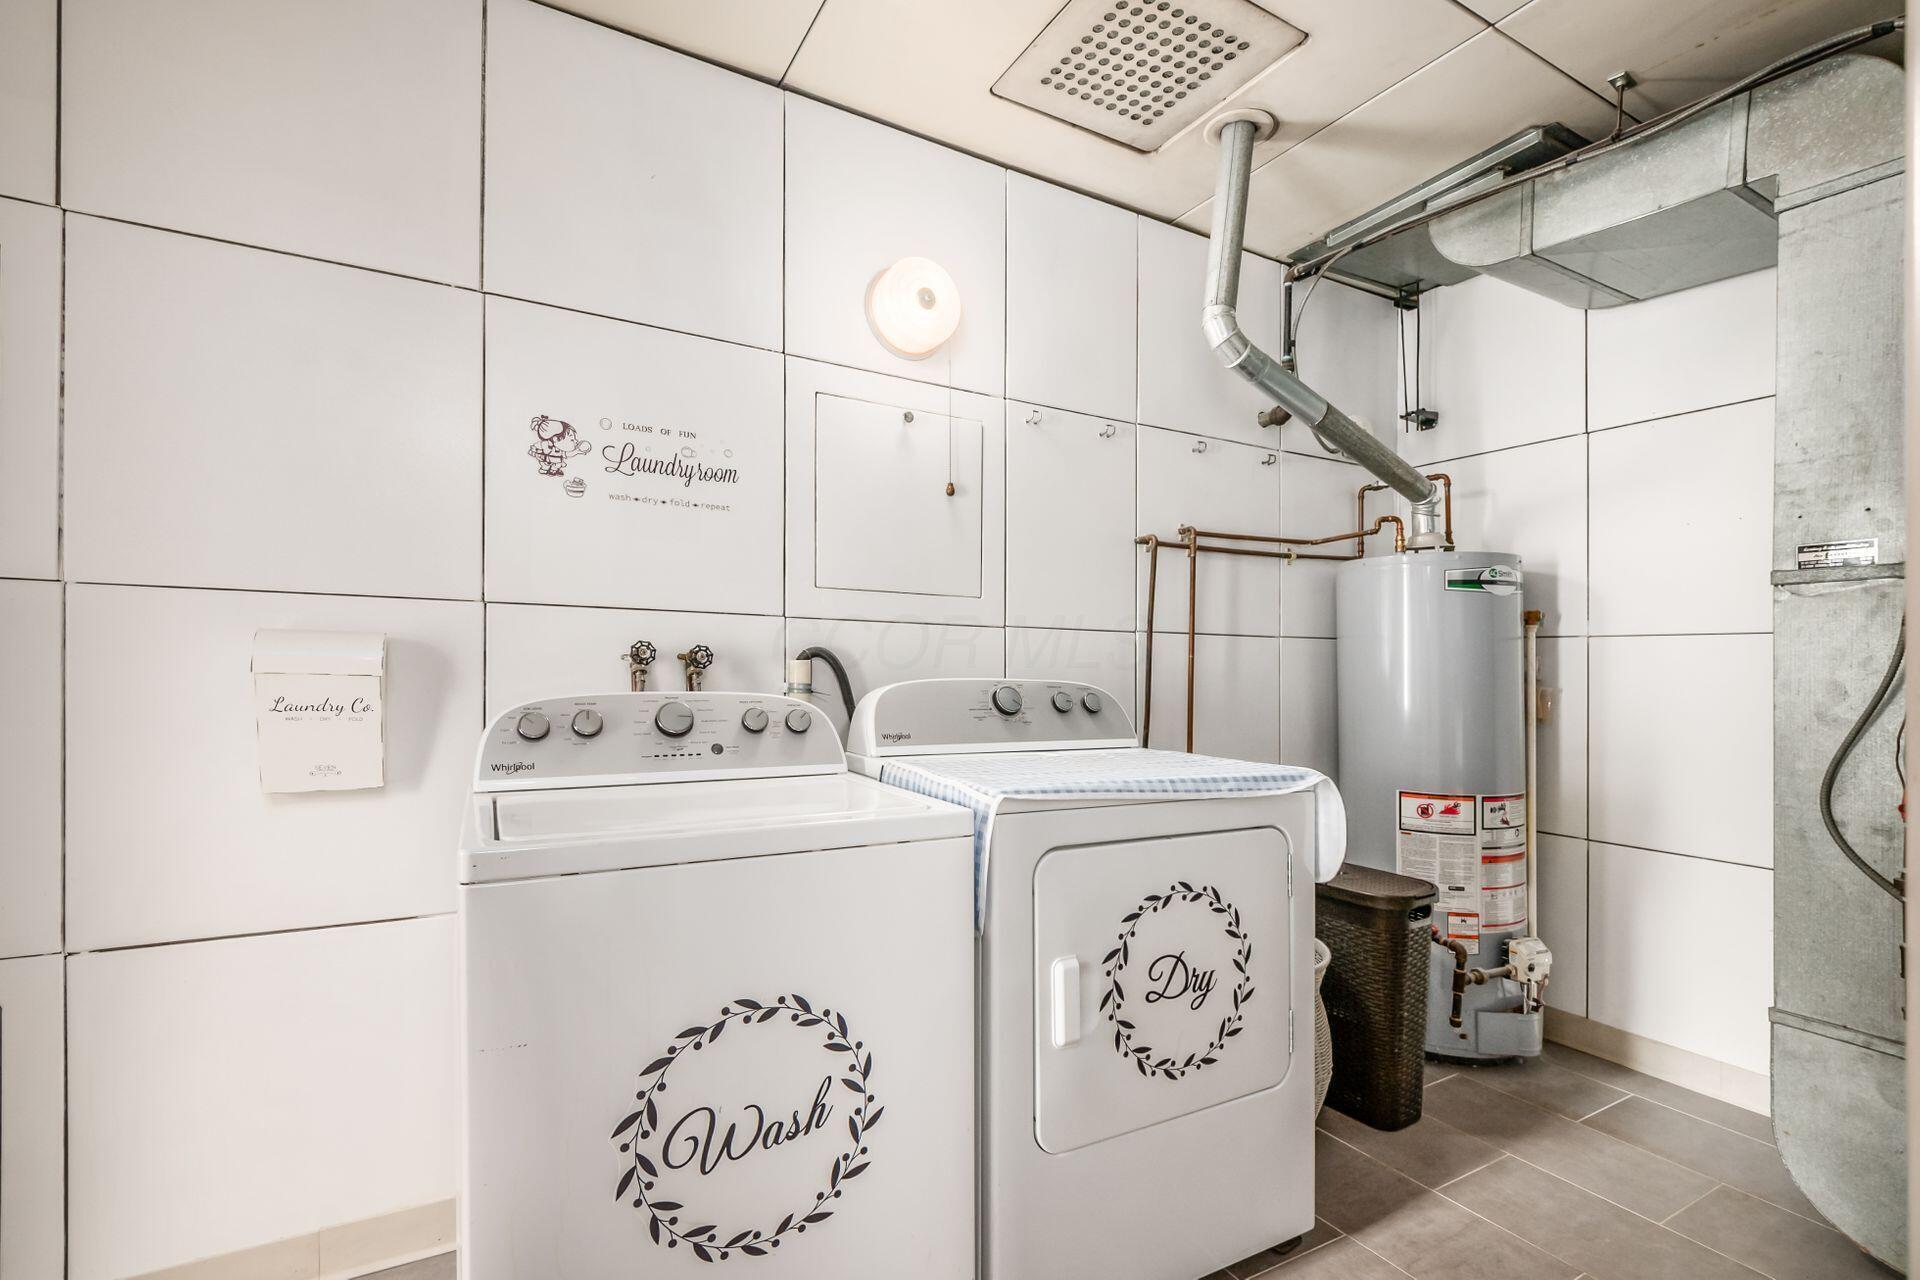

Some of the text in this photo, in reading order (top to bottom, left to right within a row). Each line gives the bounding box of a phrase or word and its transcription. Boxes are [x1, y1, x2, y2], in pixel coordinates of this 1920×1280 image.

[622, 422, 697, 439] LOADS OF FUN
[602, 442, 739, 487] Laundryroom
[608, 493, 731, 512] wash dry fold repeat
[268, 696, 375, 717] Laundry Co.
[490, 761, 536, 776] Whirlpool
[1145, 950, 1218, 1011] Dry
[662, 1075, 834, 1176] Wash
